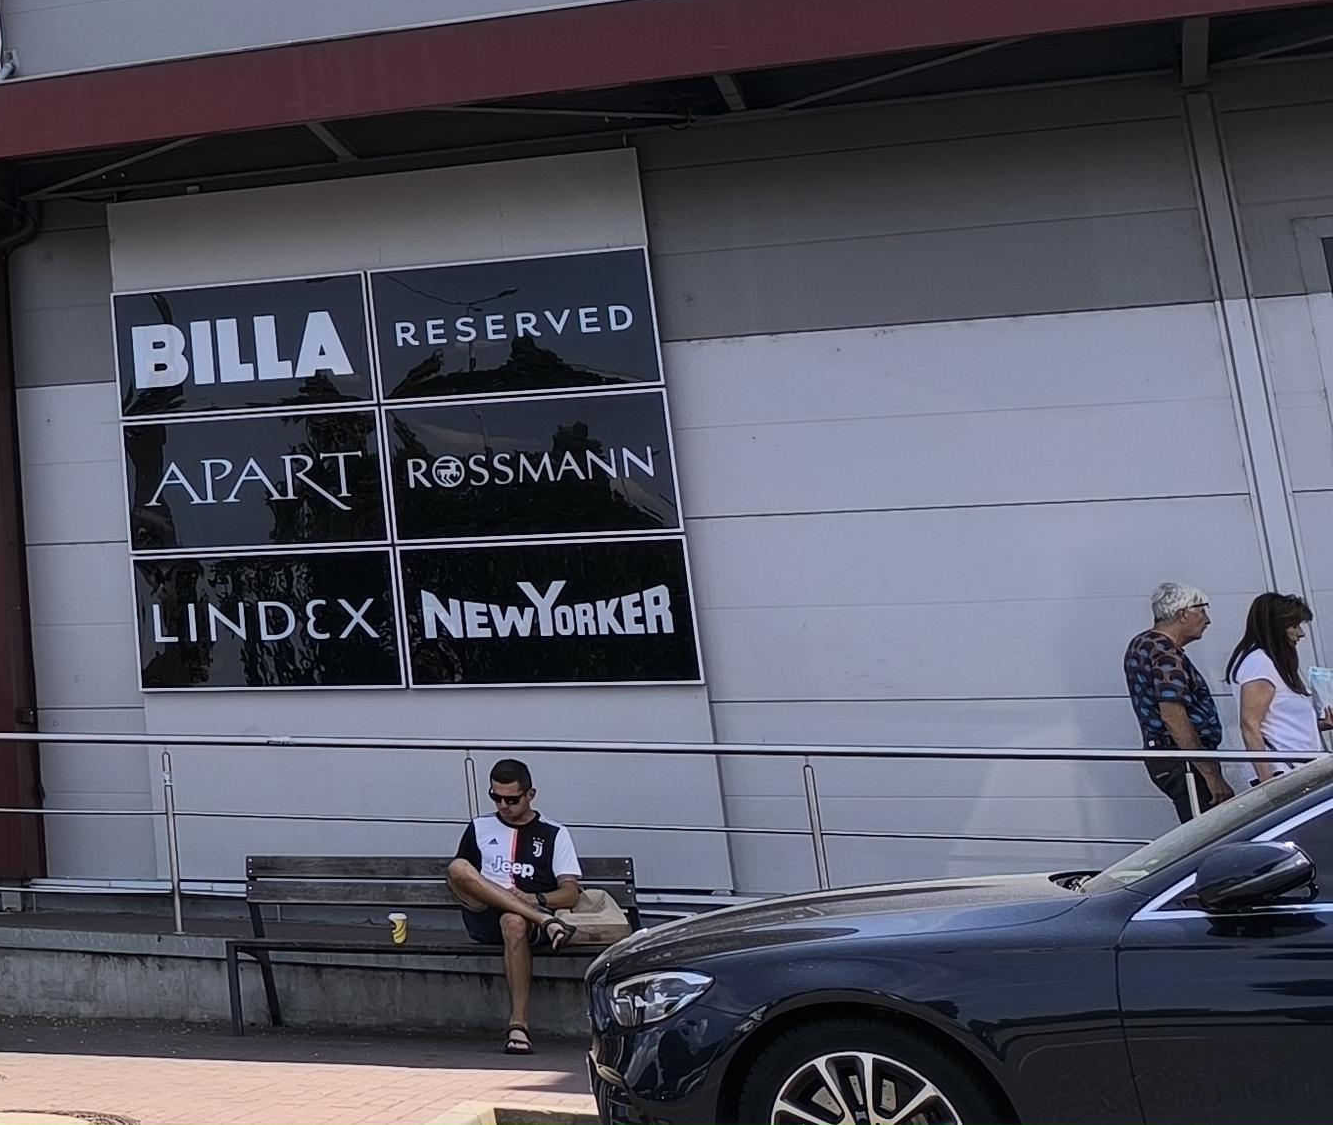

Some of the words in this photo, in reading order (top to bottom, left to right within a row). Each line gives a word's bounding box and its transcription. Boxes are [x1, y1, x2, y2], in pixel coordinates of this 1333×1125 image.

[395, 305, 633, 347] RESERVED
[131, 310, 355, 389] BILLA
[144, 450, 362, 511] APART
[406, 445, 655, 489] ROSSMANN
[152, 598, 380, 643] LINDEX
[491, 855, 535, 879] Jeep
